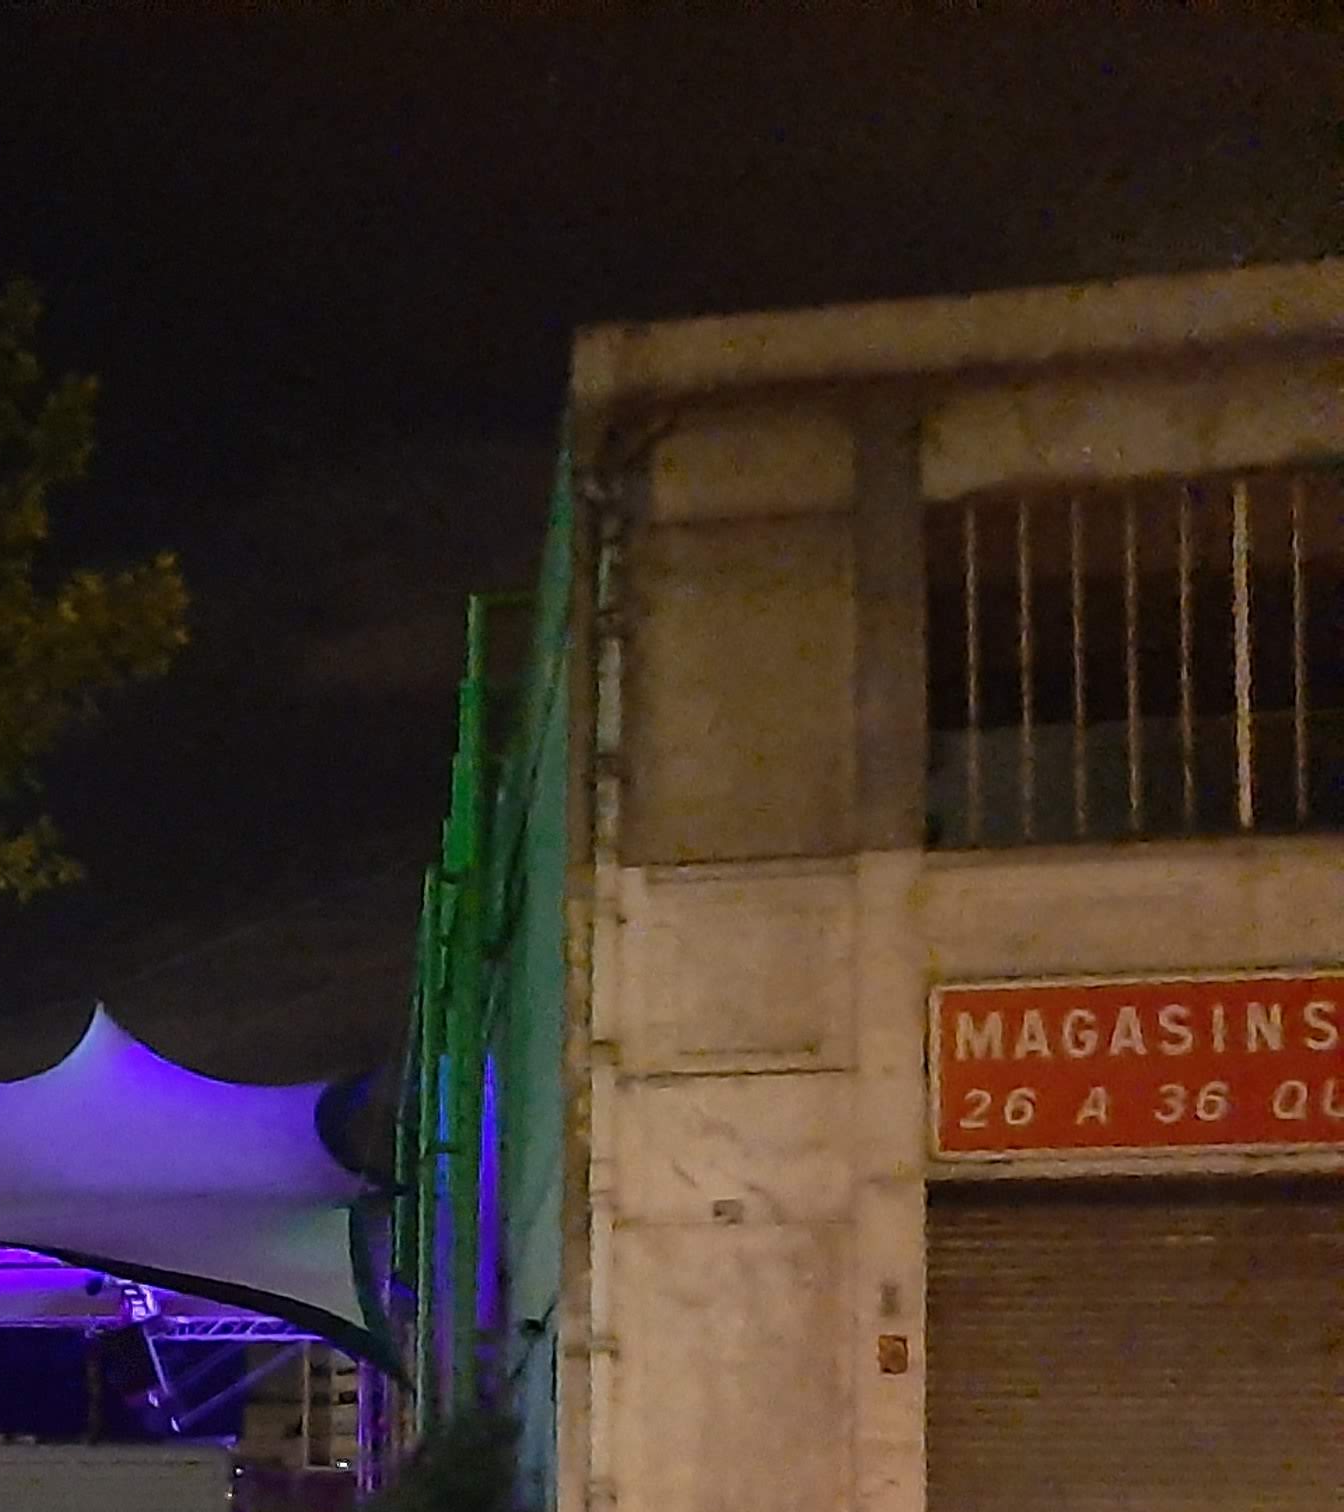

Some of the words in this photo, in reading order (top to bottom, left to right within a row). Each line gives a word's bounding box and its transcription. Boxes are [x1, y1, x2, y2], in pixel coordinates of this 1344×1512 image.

[954, 1001, 1339, 1061] MAGASINS
[959, 1087, 1037, 1129] 26
[1075, 1085, 1109, 1125] A
[1154, 1081, 1230, 1124] 36
